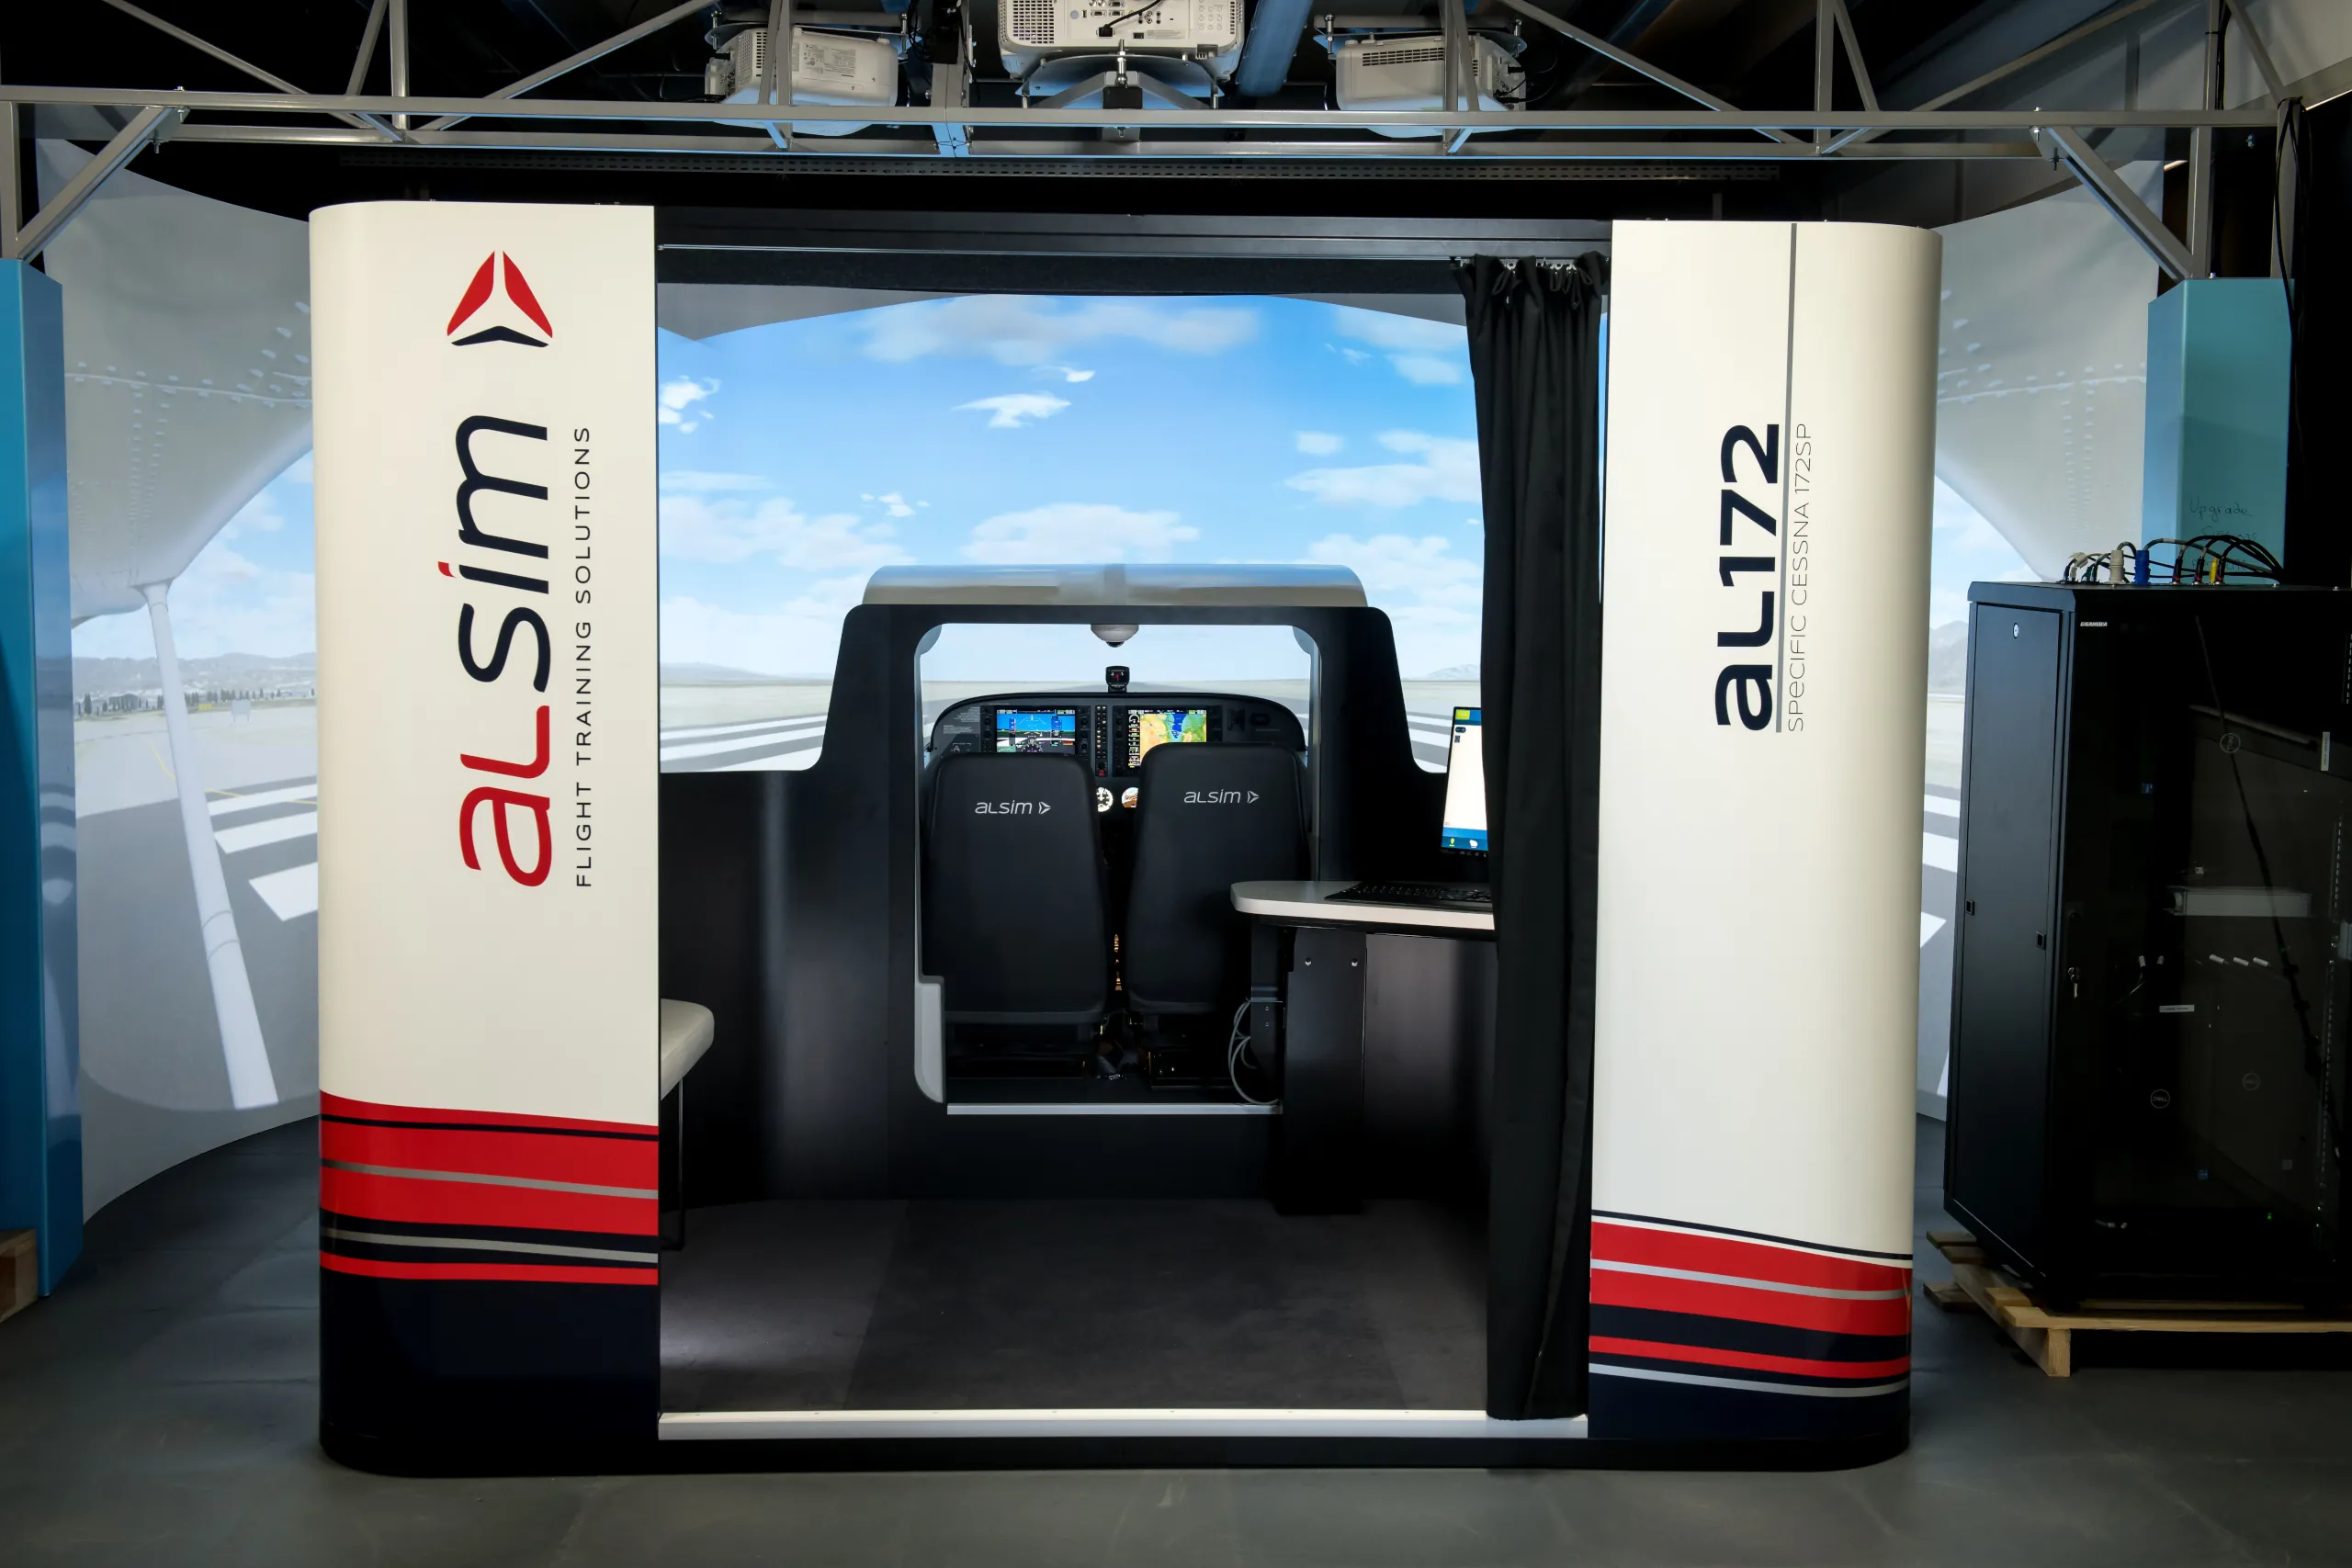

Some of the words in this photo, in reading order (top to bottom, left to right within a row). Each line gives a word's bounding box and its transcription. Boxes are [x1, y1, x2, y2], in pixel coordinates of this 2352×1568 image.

[1793, 423, 1812, 495] 172SP
[2190, 496, 2253, 523] Upgrade
[573, 427, 592, 604] SOLUTIONS
[1791, 502, 1810, 606] CESSNA
[575, 622, 592, 767] TRAINING
[575, 781, 593, 887] FLIGHT
